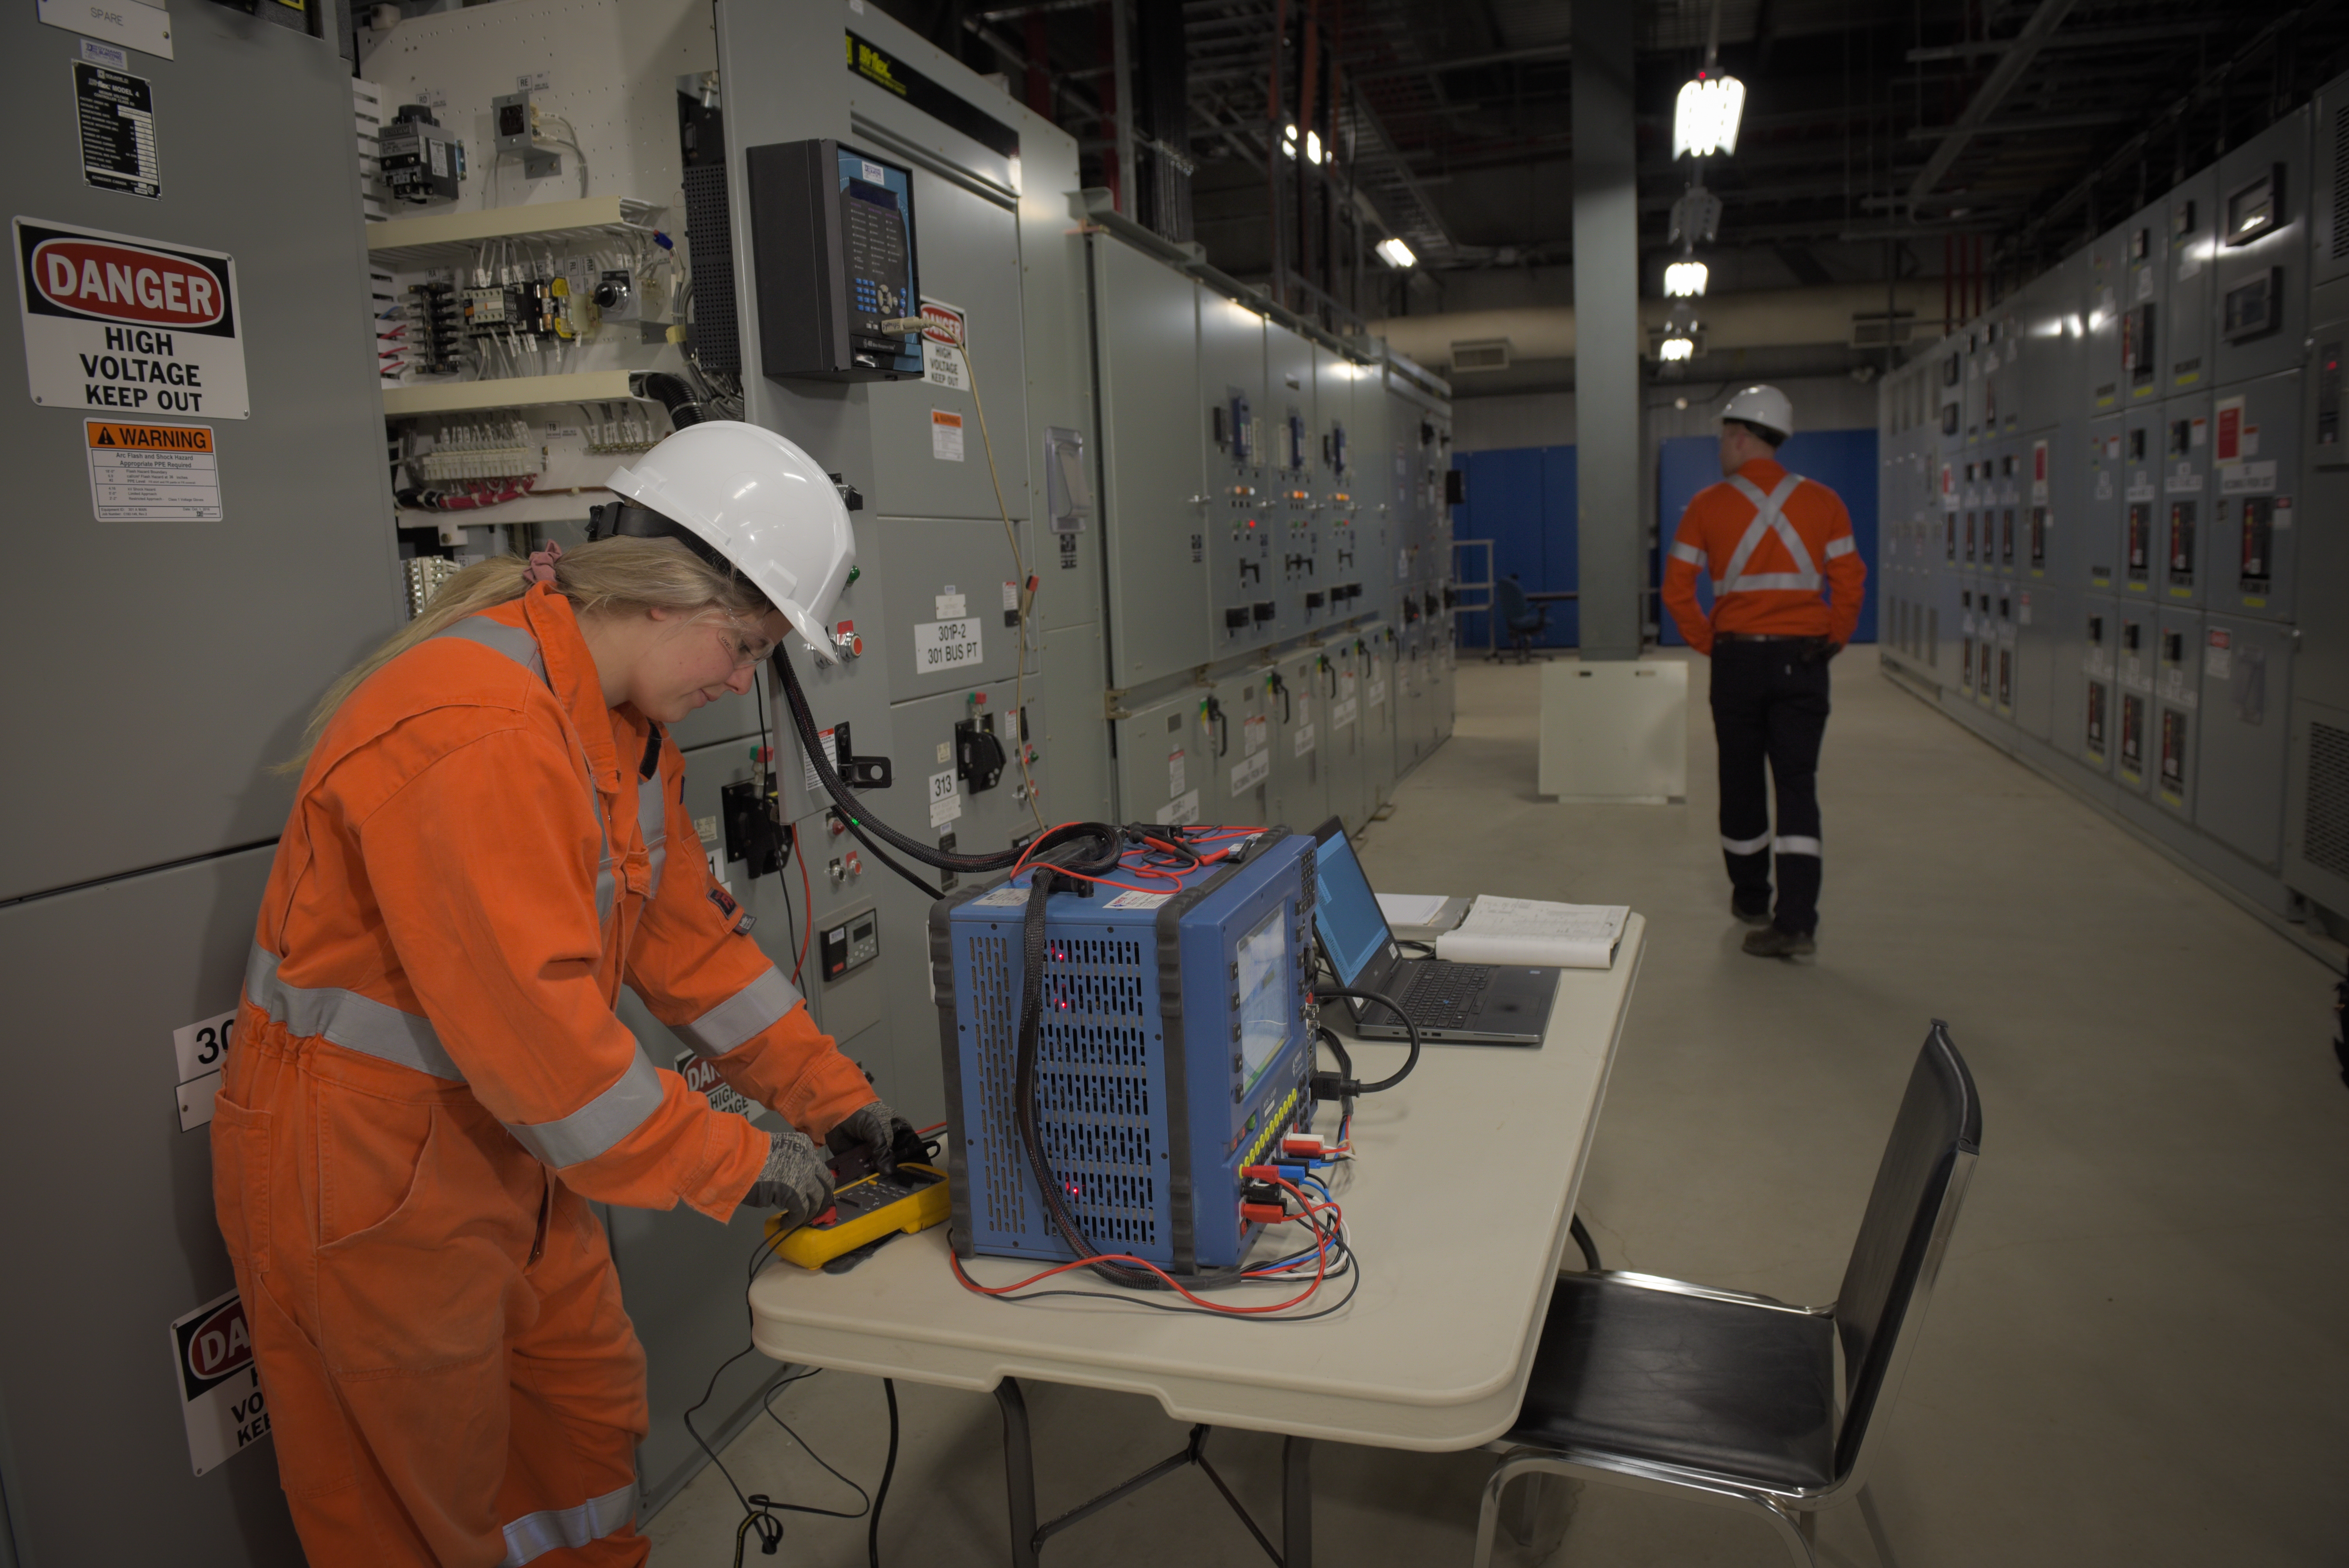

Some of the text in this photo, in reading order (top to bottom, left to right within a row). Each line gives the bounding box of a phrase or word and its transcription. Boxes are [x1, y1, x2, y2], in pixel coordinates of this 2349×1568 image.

[90, 7, 123, 26] SPARE
[112, 85, 133, 96] MODEL
[520, 78, 528, 87] RE
[94, 93, 117, 101] CONTROLLER
[419, 96, 427, 104] RD
[569, 261, 576, 272] RL
[586, 259, 594, 271] RM
[46, 253, 214, 317] DANGER
[105, 326, 173, 356] HIGH
[935, 345, 952, 359] HIGH
[79, 353, 202, 387] VOLTAGE
[930, 357, 958, 374] VOLTAGE
[931, 372, 958, 386] KEEP OUT
[85, 384, 202, 412] KEEP OUT
[119, 427, 206, 449] WARNING
[459, 559, 467, 567] TC
[939, 624, 966, 641] 301P-2
[928, 642, 977, 664] 301 BUS PT
[935, 775, 952, 796] 313
[196, 1019, 234, 1064] 30
[687, 1060, 722, 1092] DAN
[710, 1086, 737, 1110] HIGH
[237, 1412, 272, 1448] KEE
